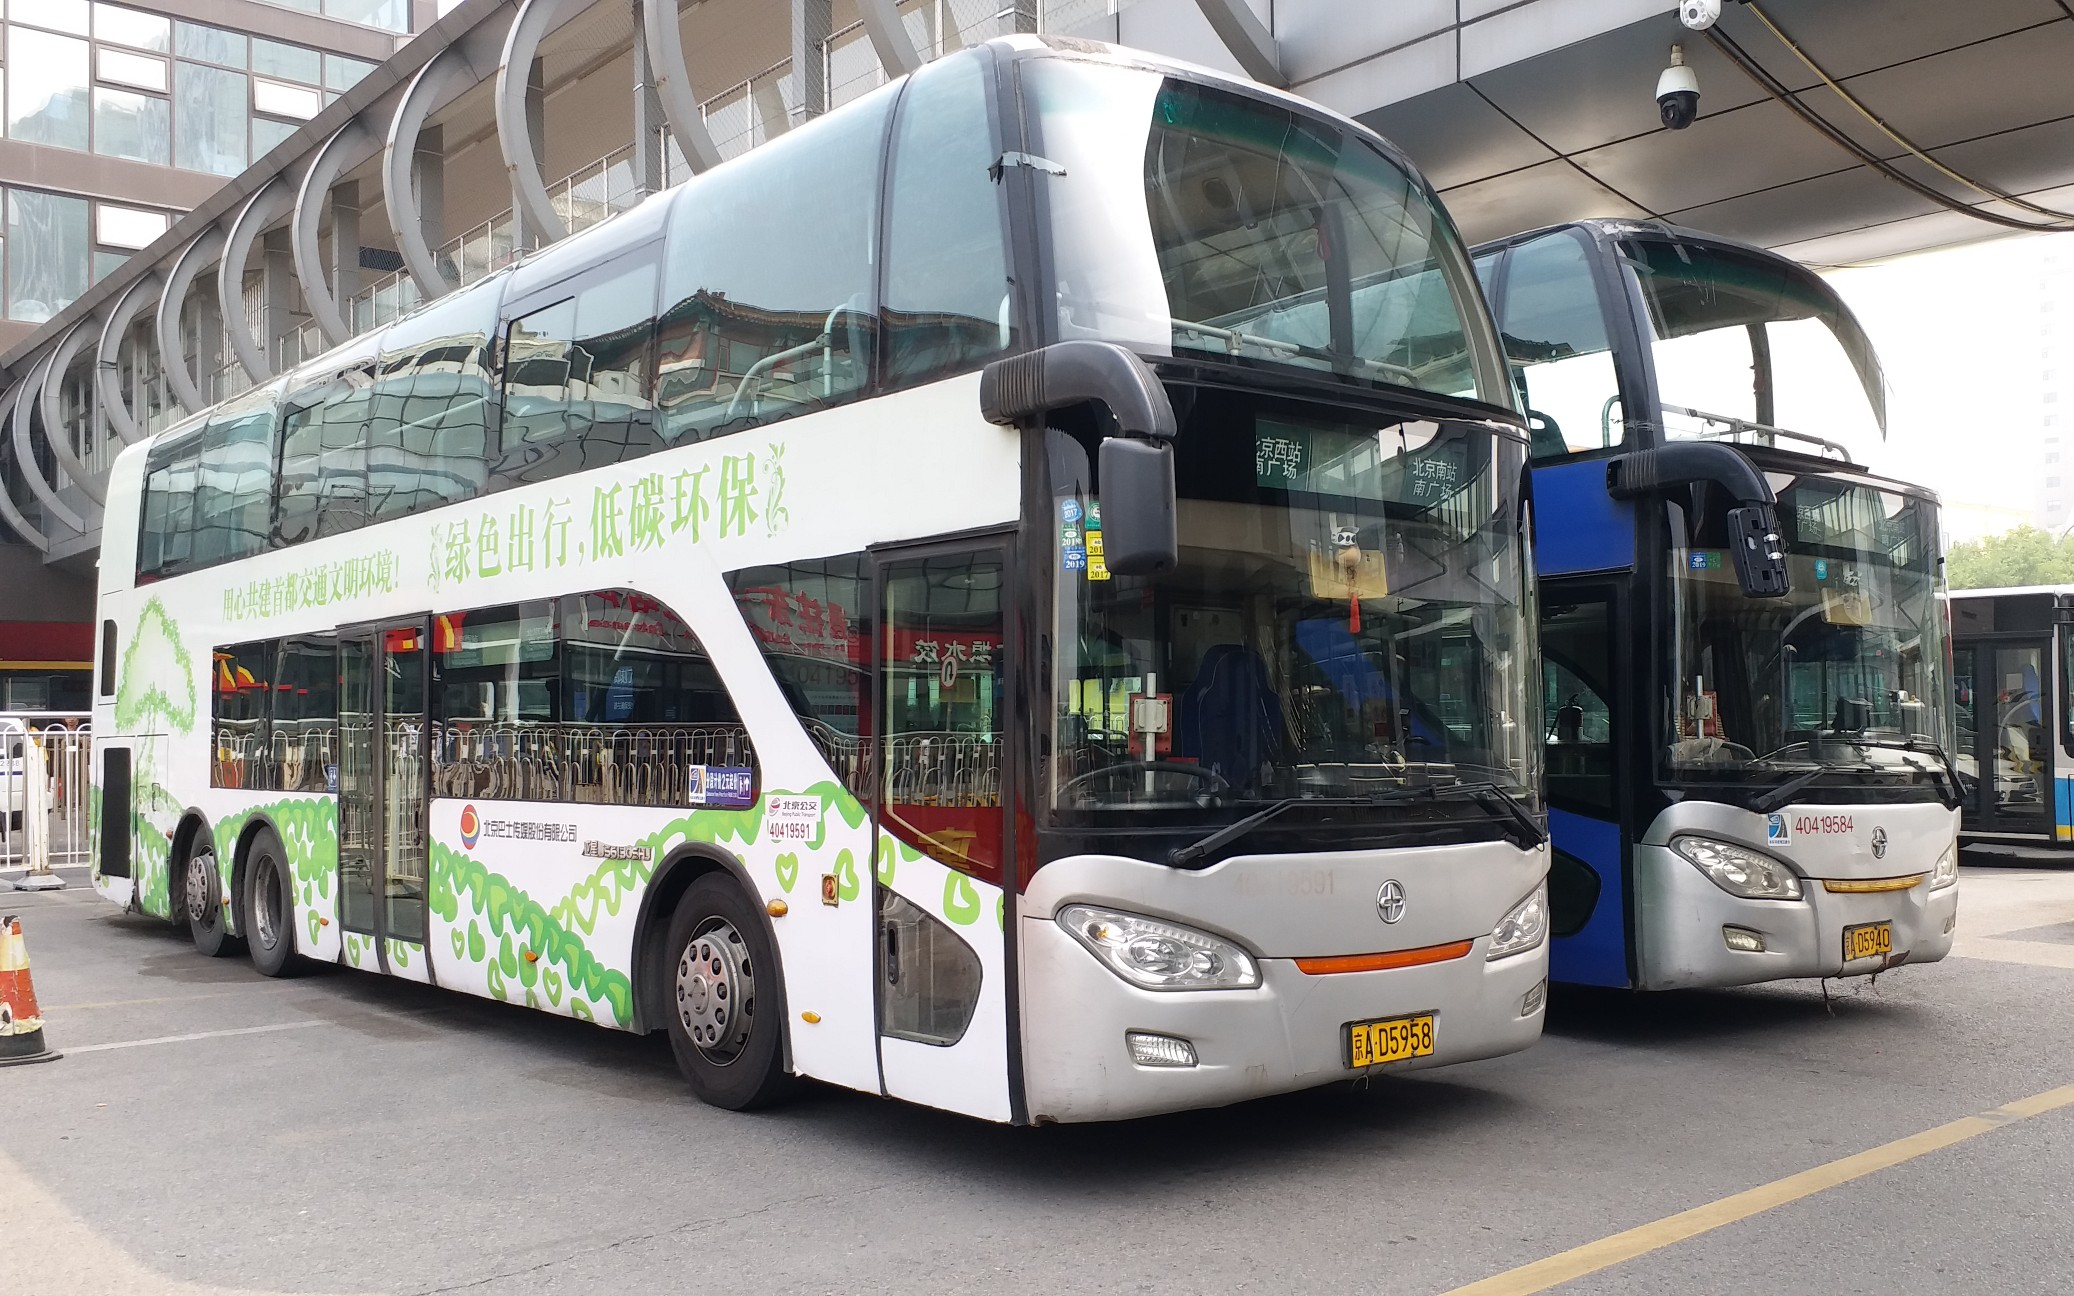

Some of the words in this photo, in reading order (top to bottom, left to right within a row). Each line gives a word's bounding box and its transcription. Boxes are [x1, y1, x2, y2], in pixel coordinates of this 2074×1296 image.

[1256, 436, 1303, 463] 京西站
[1412, 457, 1457, 482] 北京南站
[1089, 546, 1103, 554] 201
[1065, 560, 1085, 569] 2019
[1090, 571, 1109, 579] 2017
[782, 801, 817, 811] 北京公交
[483, 820, 577, 842] 北京巴士传媒股份有限公司
[769, 822, 810, 839] 40419591
[1795, 815, 1853, 834] 40419584
